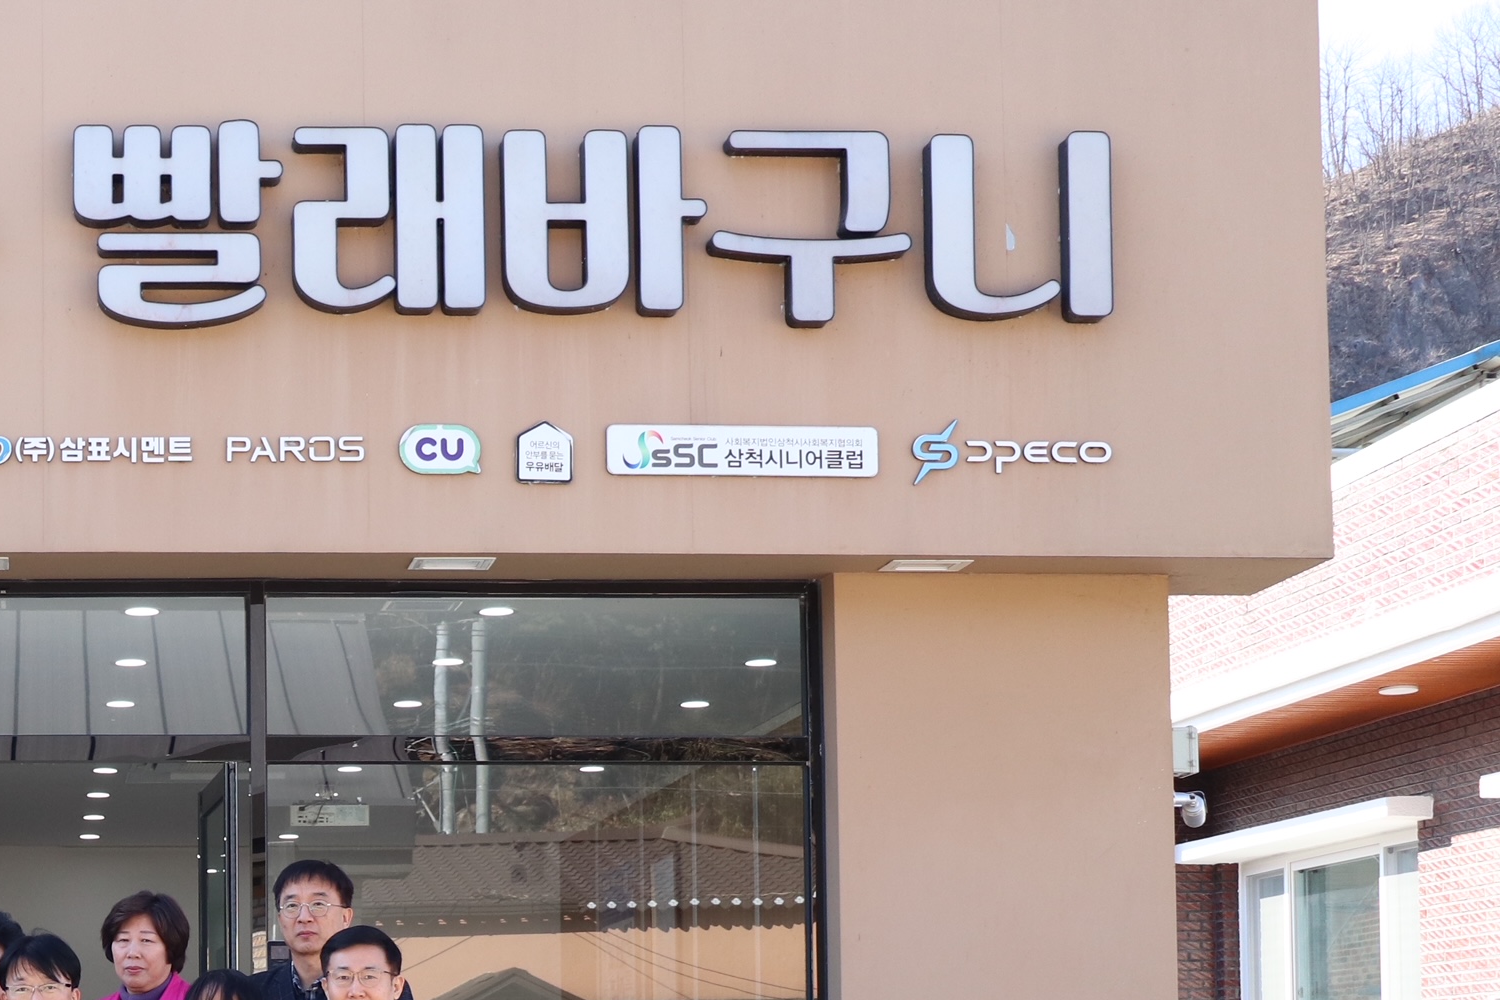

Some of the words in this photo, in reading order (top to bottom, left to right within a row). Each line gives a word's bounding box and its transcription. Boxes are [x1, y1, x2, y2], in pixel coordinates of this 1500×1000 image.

[72, 119, 1114, 331] 빨래바구니
[14, 435, 194, 464] (주)삼표시멘트
[225, 436, 366, 464] PAROS
[415, 437, 465, 461] CU
[529, 440, 560, 450] 어르신의
[525, 461, 564, 473] 우유배달
[724, 447, 864, 470] 삼척시니어클럽
